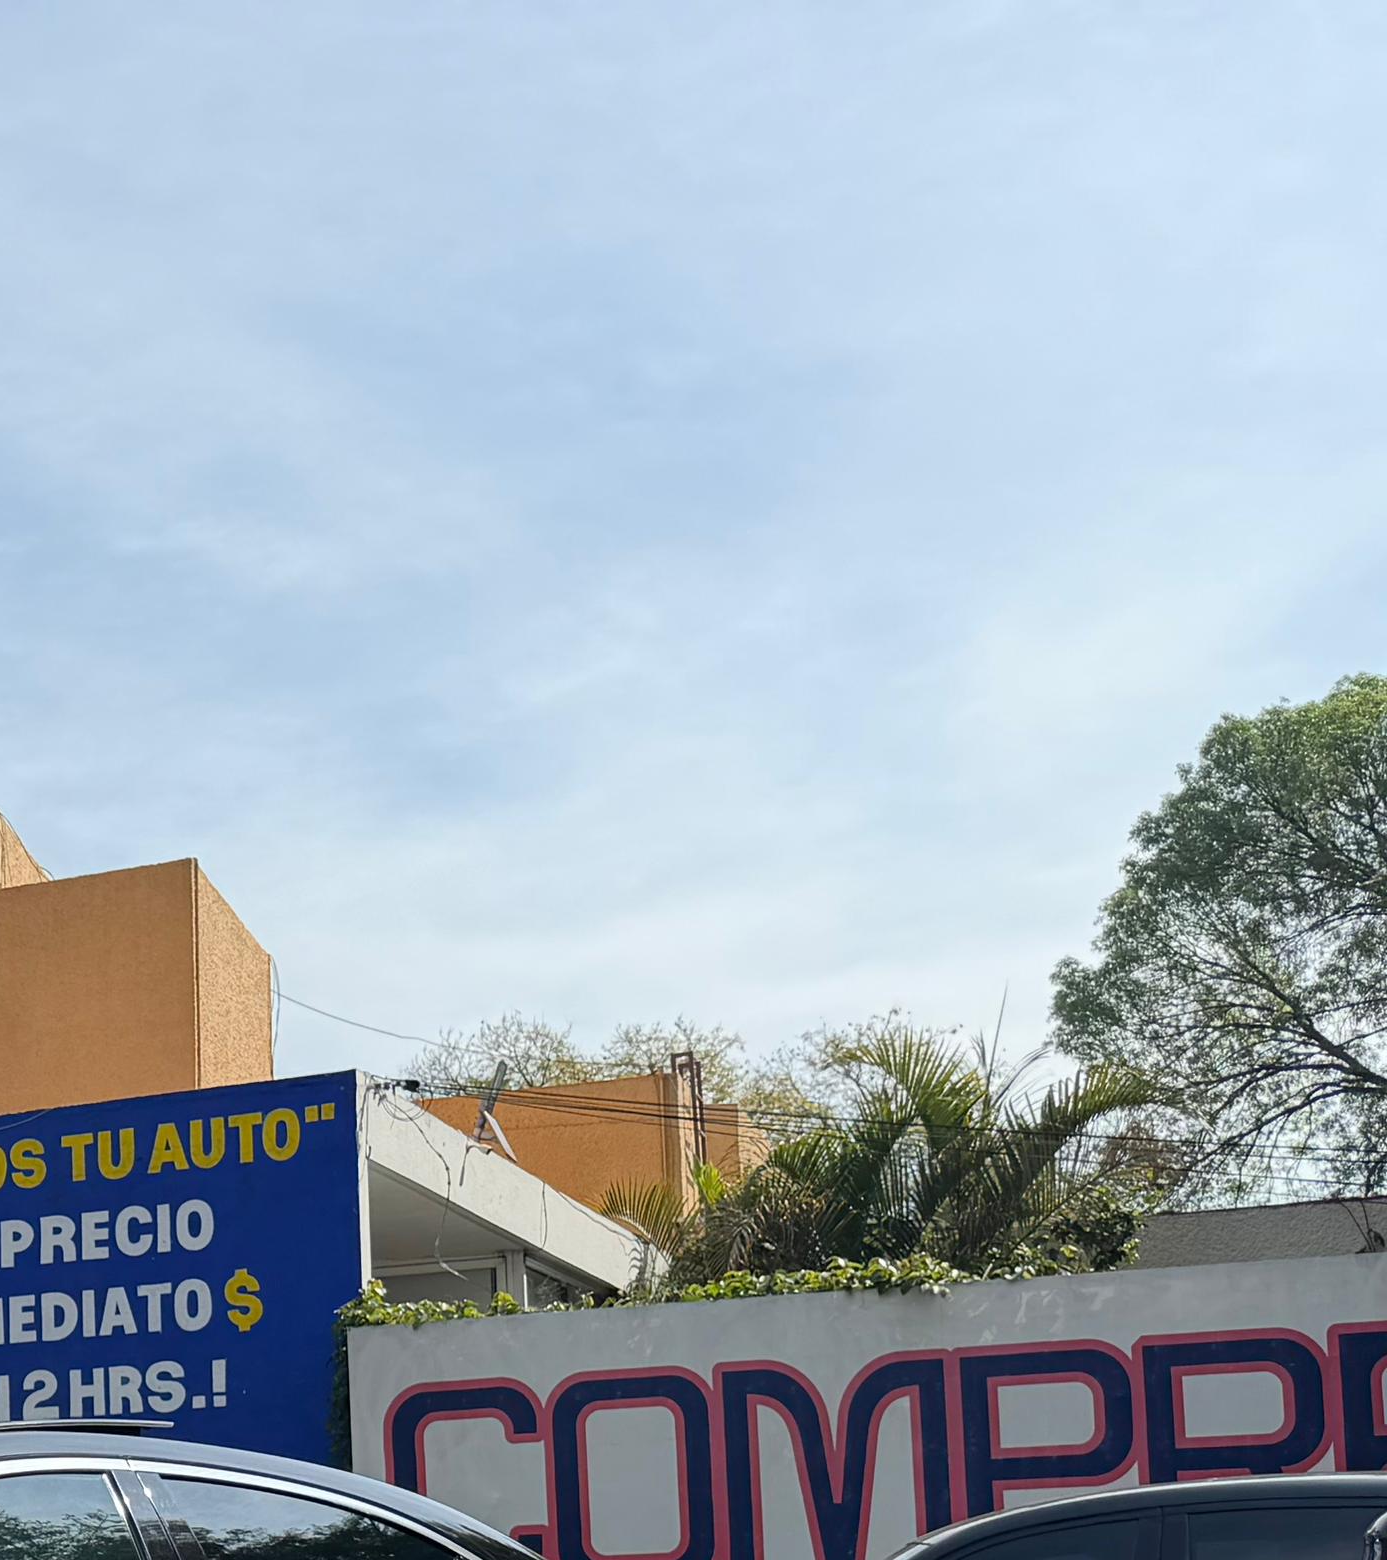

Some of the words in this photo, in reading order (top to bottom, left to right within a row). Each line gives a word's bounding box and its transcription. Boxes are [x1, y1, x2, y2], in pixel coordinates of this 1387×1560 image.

[61, 1128, 135, 1182] TU
[147, 1102, 335, 1174] AUTO"
[0, 1199, 214, 1268] PRECIO
[22, 1369, 60, 1420] 2
[69, 1359, 227, 1418] HRS.!
